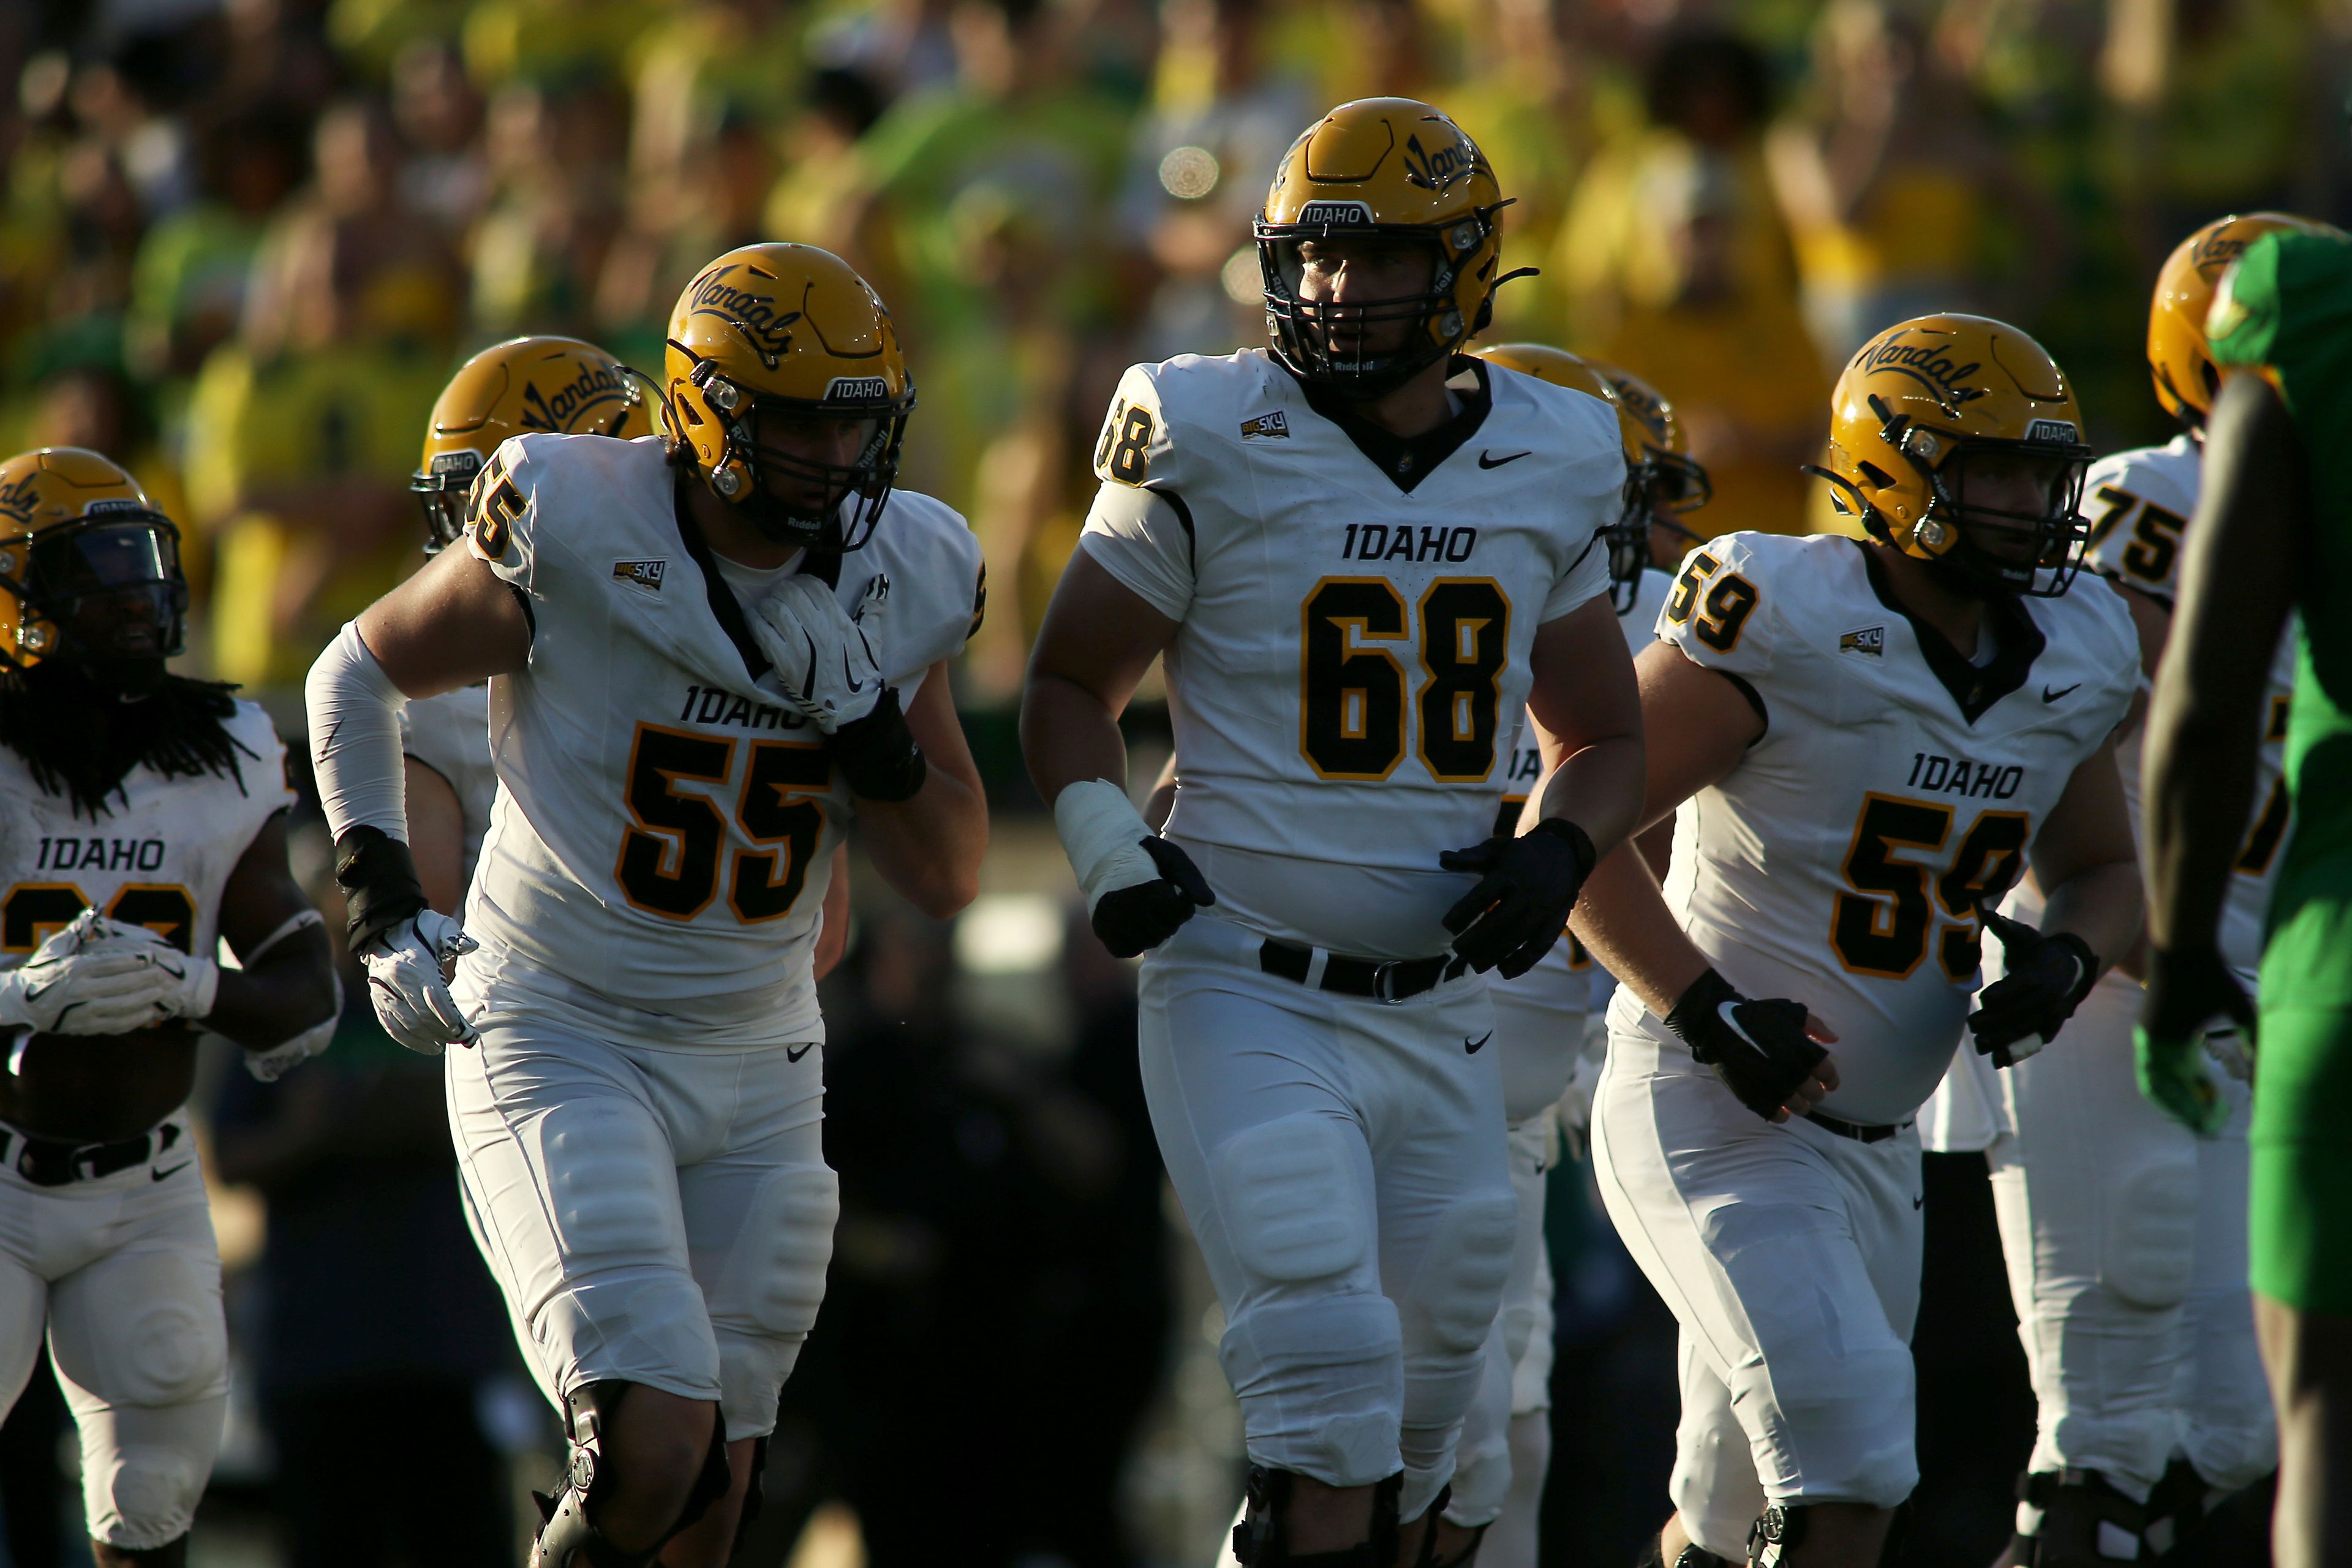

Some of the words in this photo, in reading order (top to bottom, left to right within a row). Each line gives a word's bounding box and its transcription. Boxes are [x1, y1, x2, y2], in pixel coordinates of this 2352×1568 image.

[1306, 207, 1361, 223] IDAHO
[690, 263, 801, 371] Vandals
[1335, 361, 1374, 371] Riddll
[1866, 328, 1981, 419] Vandals
[837, 382, 884, 398] IDAHO
[2035, 424, 2076, 443] IDAHO
[433, 454, 475, 473] IDAHO
[788, 517, 822, 530] Riddell
[1343, 524, 1477, 562] IDAHO
[2085, 483, 2189, 585] 75
[1665, 550, 1762, 657] 59
[1298, 575, 1512, 783] 68
[1907, 753, 2023, 799] IDAHO
[614, 720, 834, 925] 55
[37, 837, 165, 871] IDAHO
[1828, 790, 2030, 985] 59
